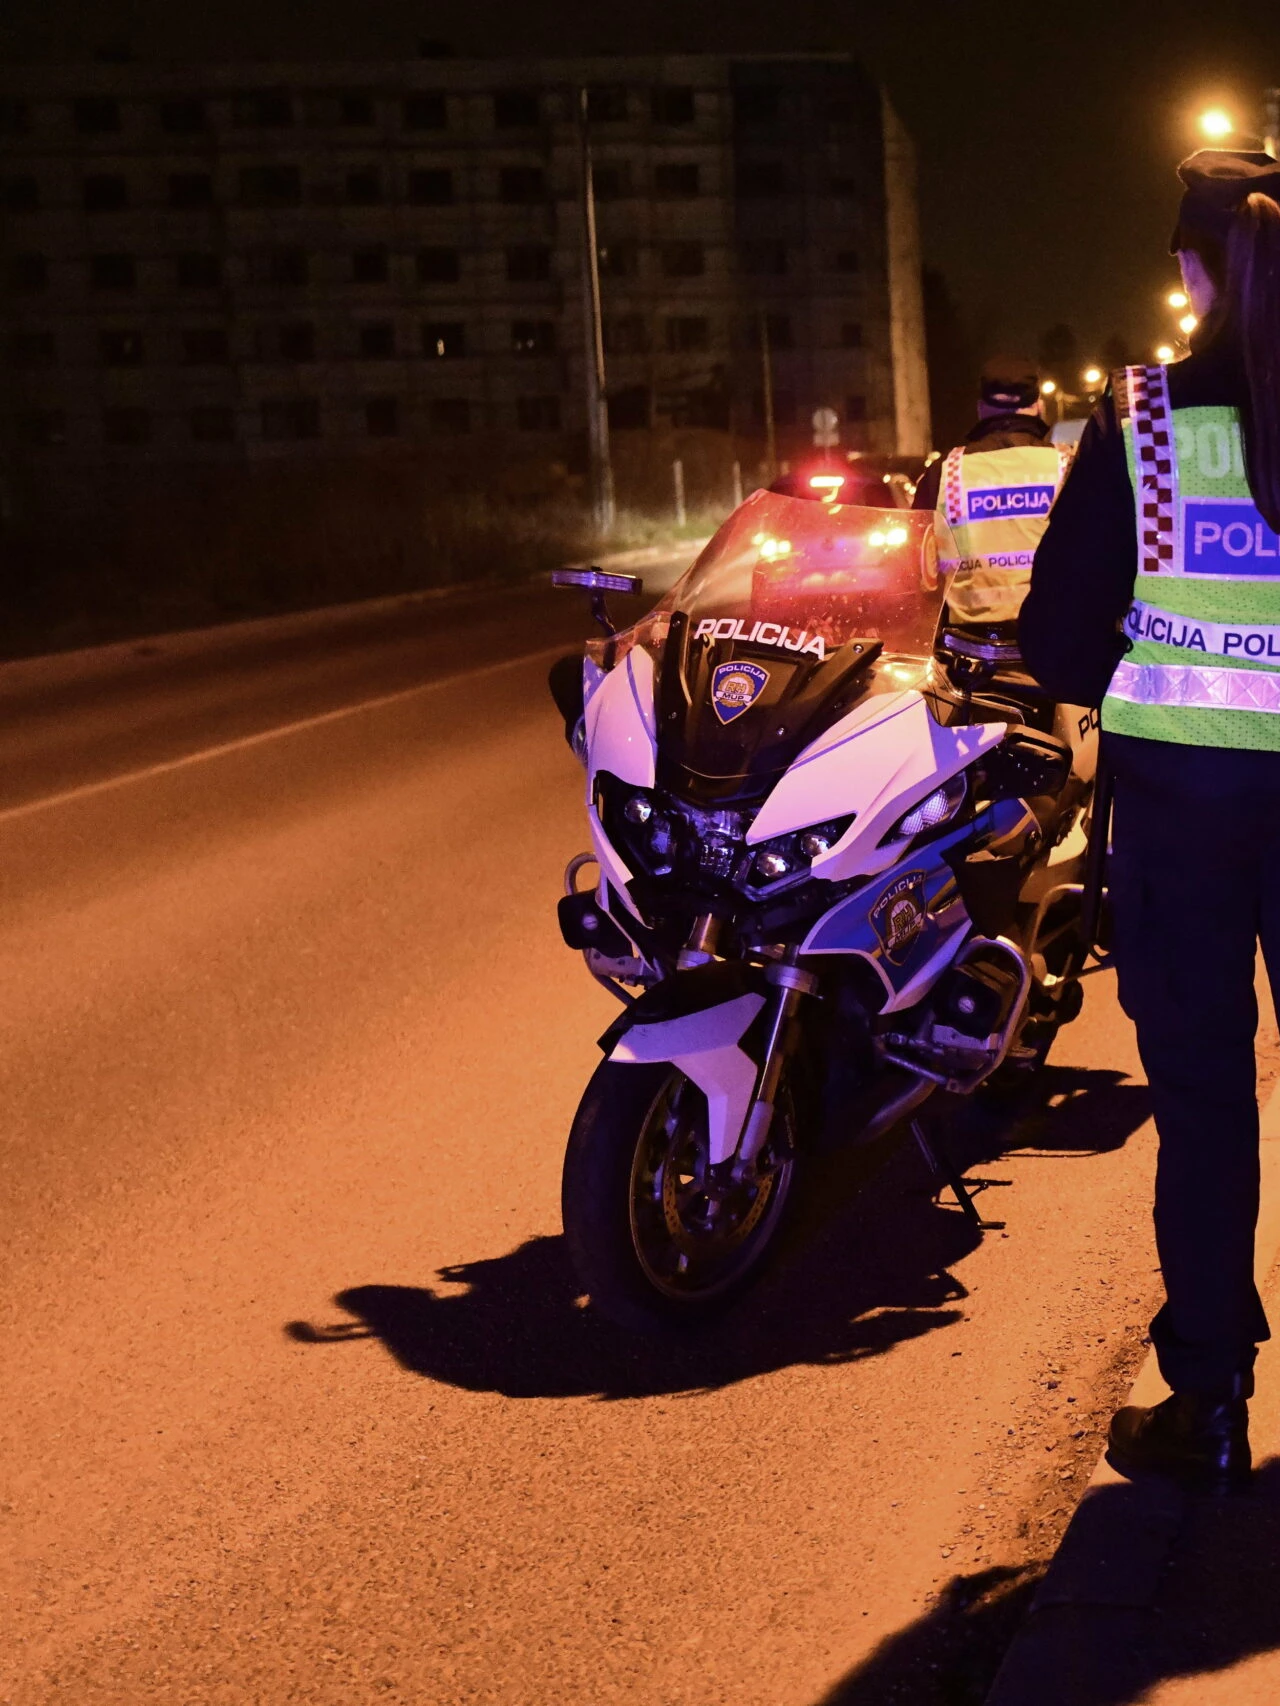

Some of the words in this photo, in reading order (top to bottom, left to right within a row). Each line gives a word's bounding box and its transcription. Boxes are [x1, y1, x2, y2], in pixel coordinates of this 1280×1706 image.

[971, 491, 1052, 513] POLICIJA
[694, 618, 826, 661] POLICIJA
[719, 664, 766, 681] POLICIJA
[722, 692, 745, 701] MUP
